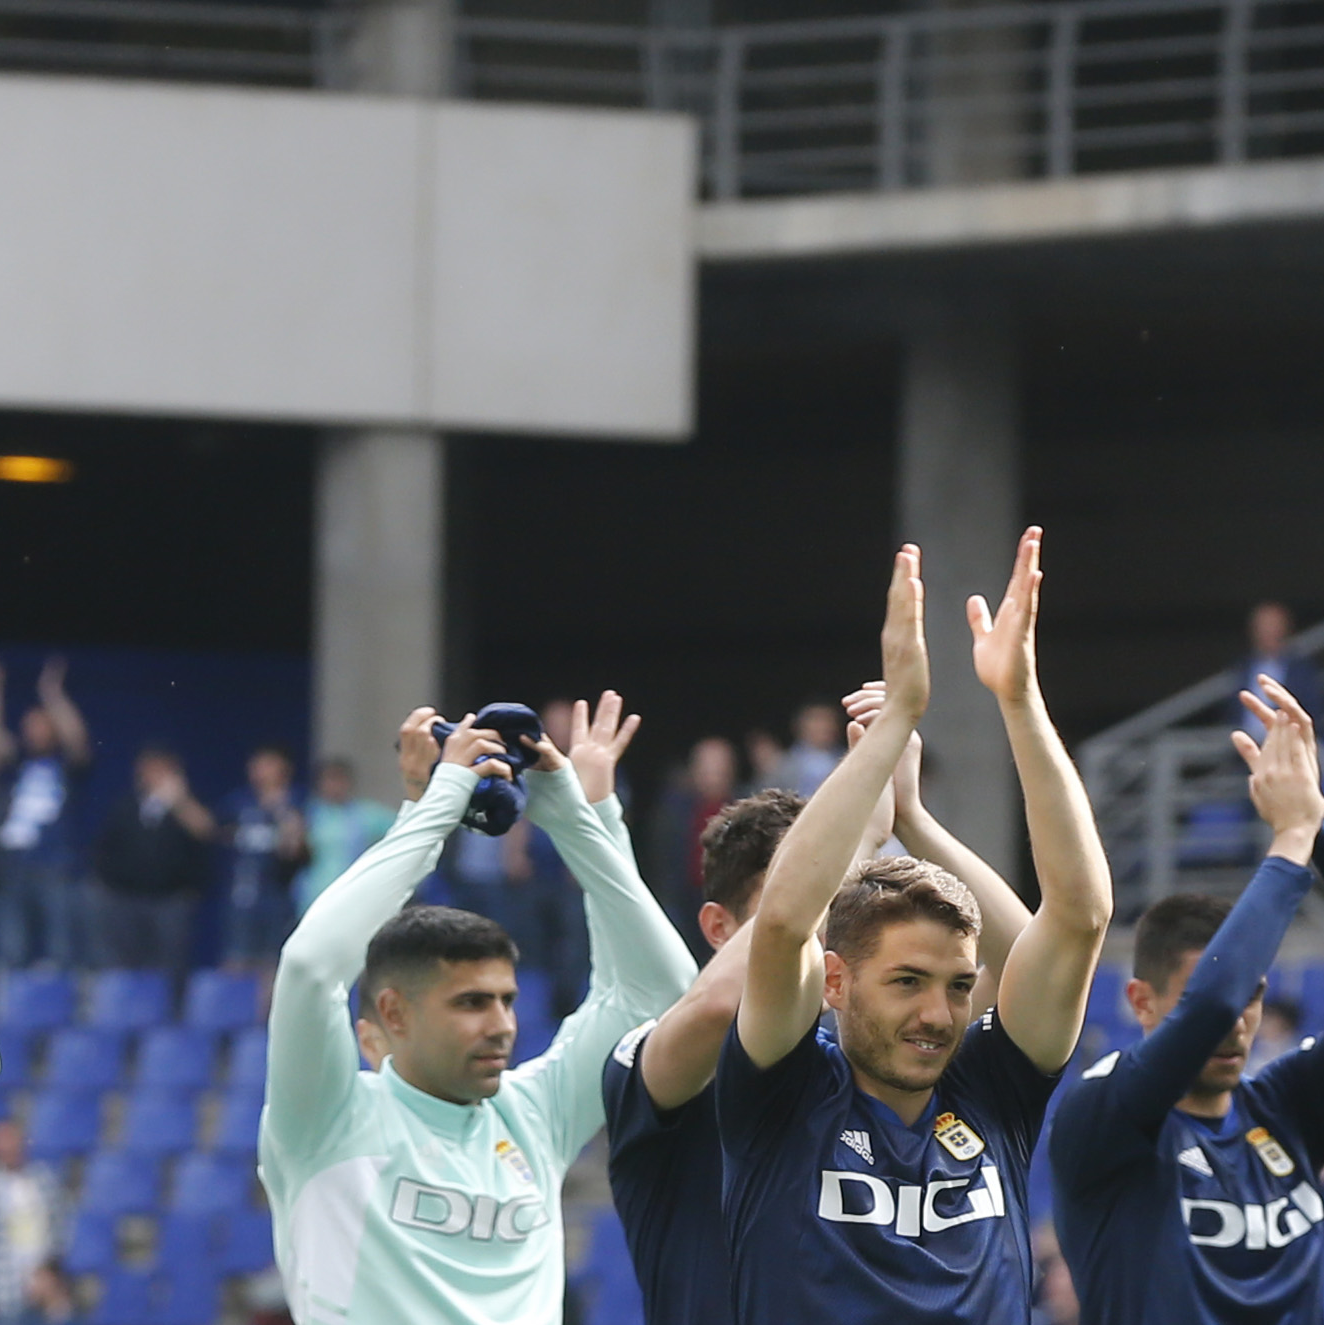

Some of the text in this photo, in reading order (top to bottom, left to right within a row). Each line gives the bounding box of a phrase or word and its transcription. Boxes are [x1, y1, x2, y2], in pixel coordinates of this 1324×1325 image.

[839, 1131, 876, 1166] adidas
[818, 1165, 1005, 1237] DIGI
[1180, 1180, 1324, 1250] DIGI
